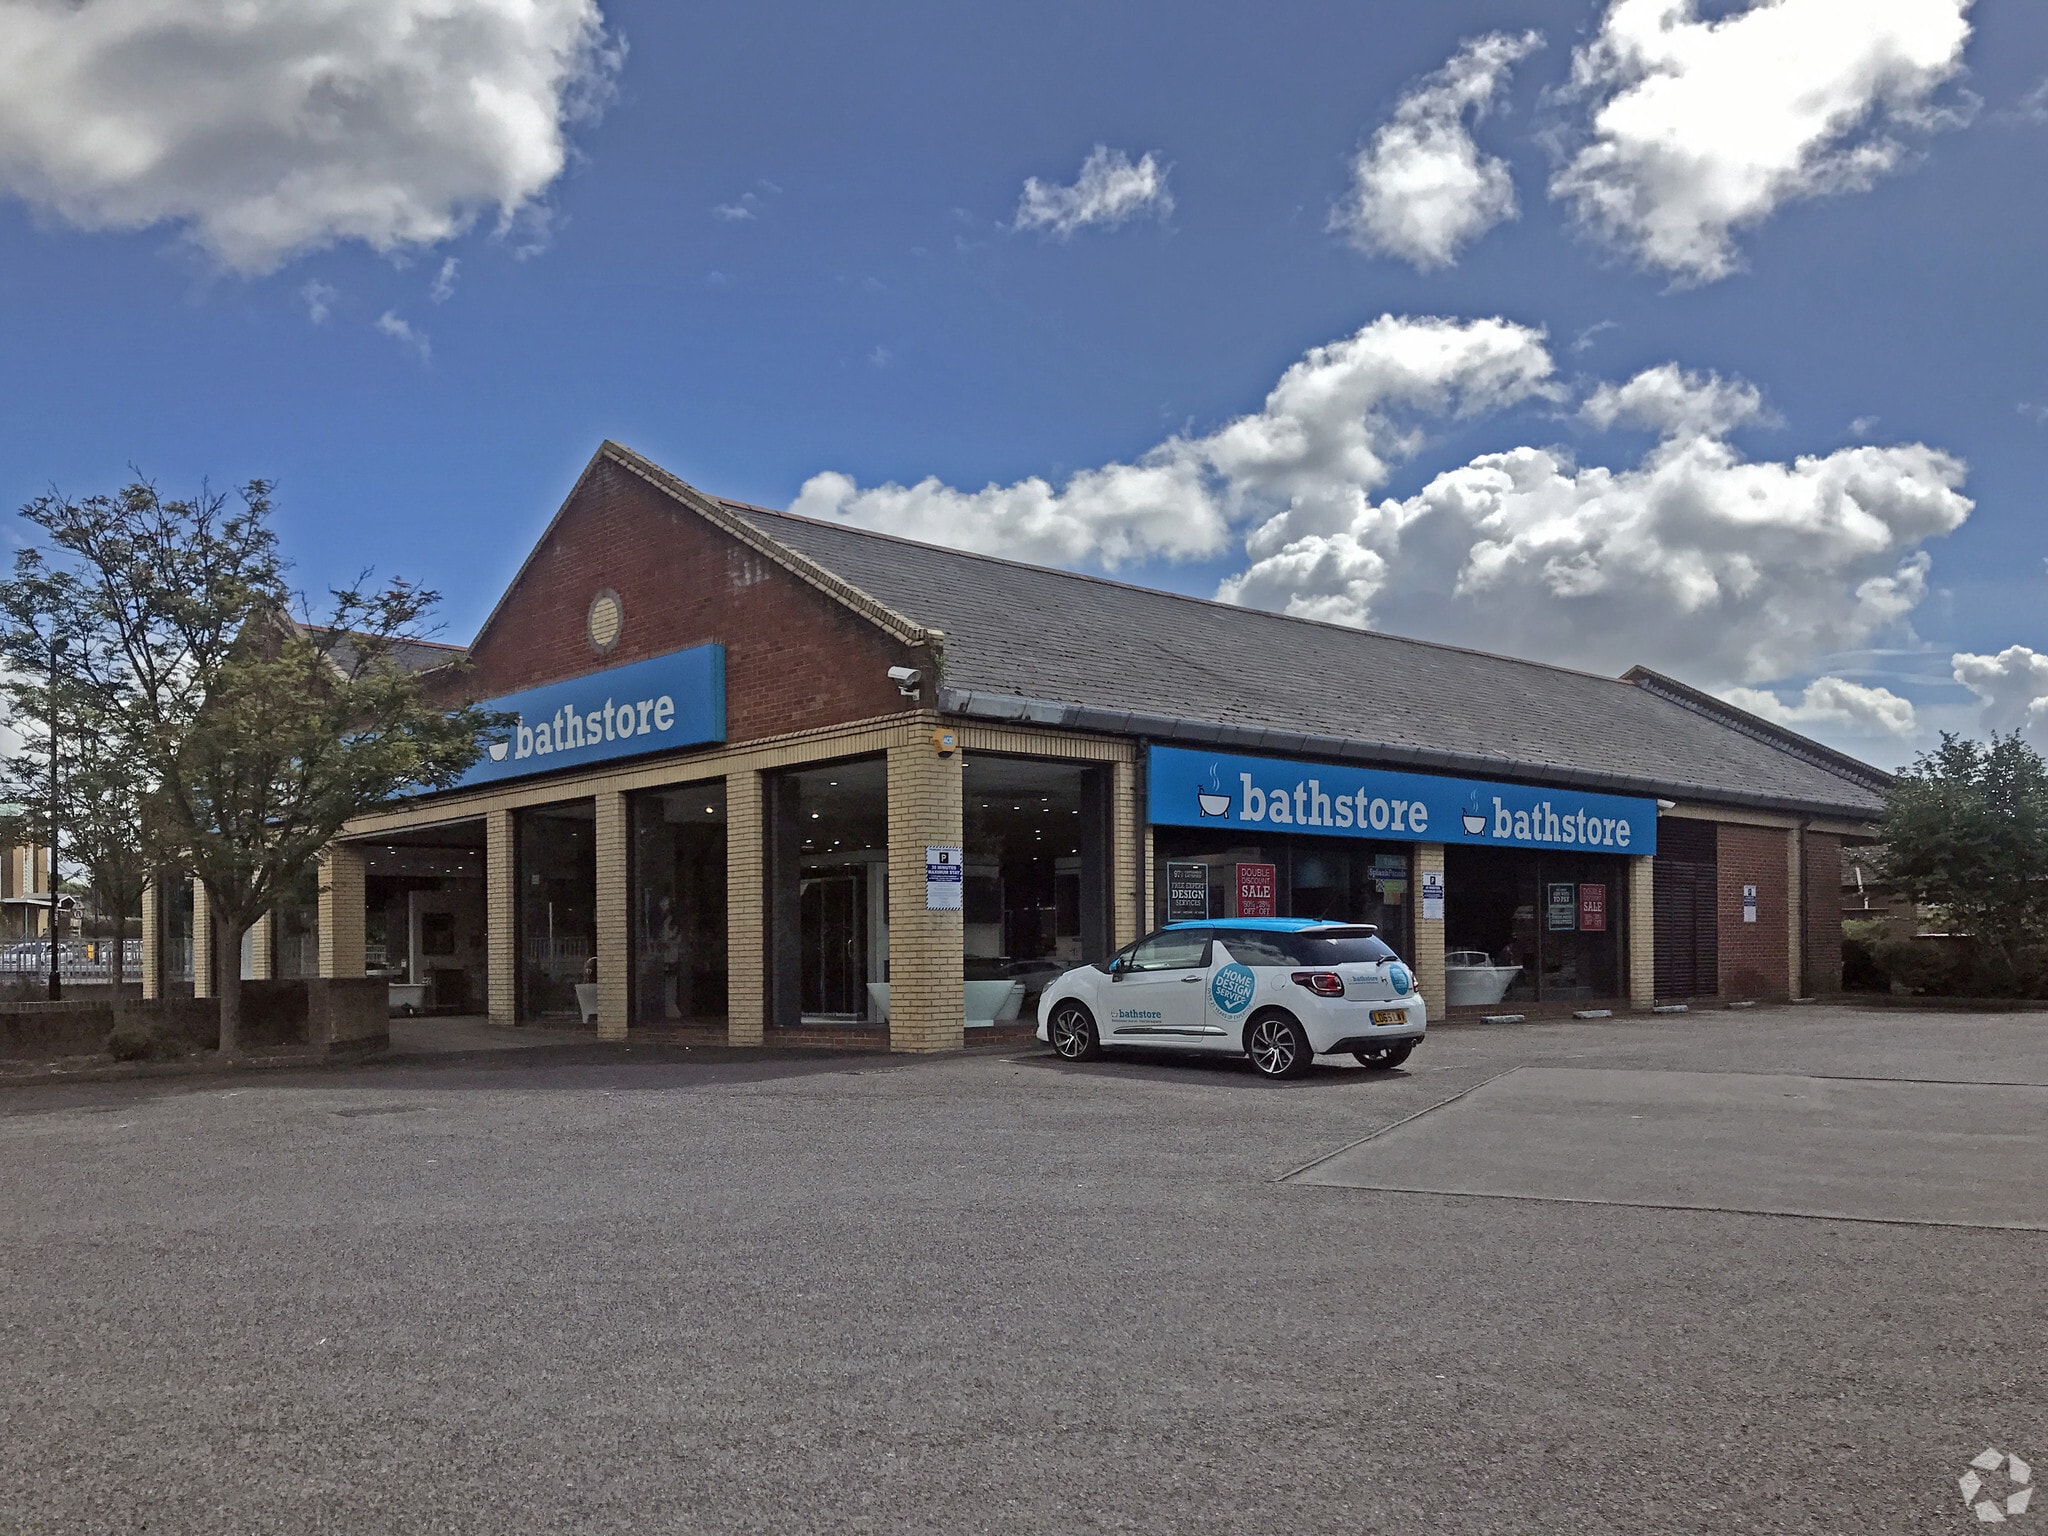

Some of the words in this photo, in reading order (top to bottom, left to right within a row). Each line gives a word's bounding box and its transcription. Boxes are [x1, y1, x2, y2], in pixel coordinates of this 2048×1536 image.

[515, 695, 675, 760] bathstore
[1239, 773, 1428, 833] bathstore
[1492, 797, 1631, 847] bathstore
[1241, 868, 1270, 877] DOUBLE
[1241, 877, 1270, 885] DISCOUNT
[1172, 890, 1205, 899] DESIGN
[1241, 885, 1271, 898] SALE
[1243, 907, 1256, 915] OFF
[1583, 901, 1602, 912] SALE
[1222, 968, 1252, 987] HOME
[1216, 976, 1251, 997] DESIGN
[1216, 986, 1246, 1005] SERVICE
[1119, 1009, 1161, 1018] bathstore
